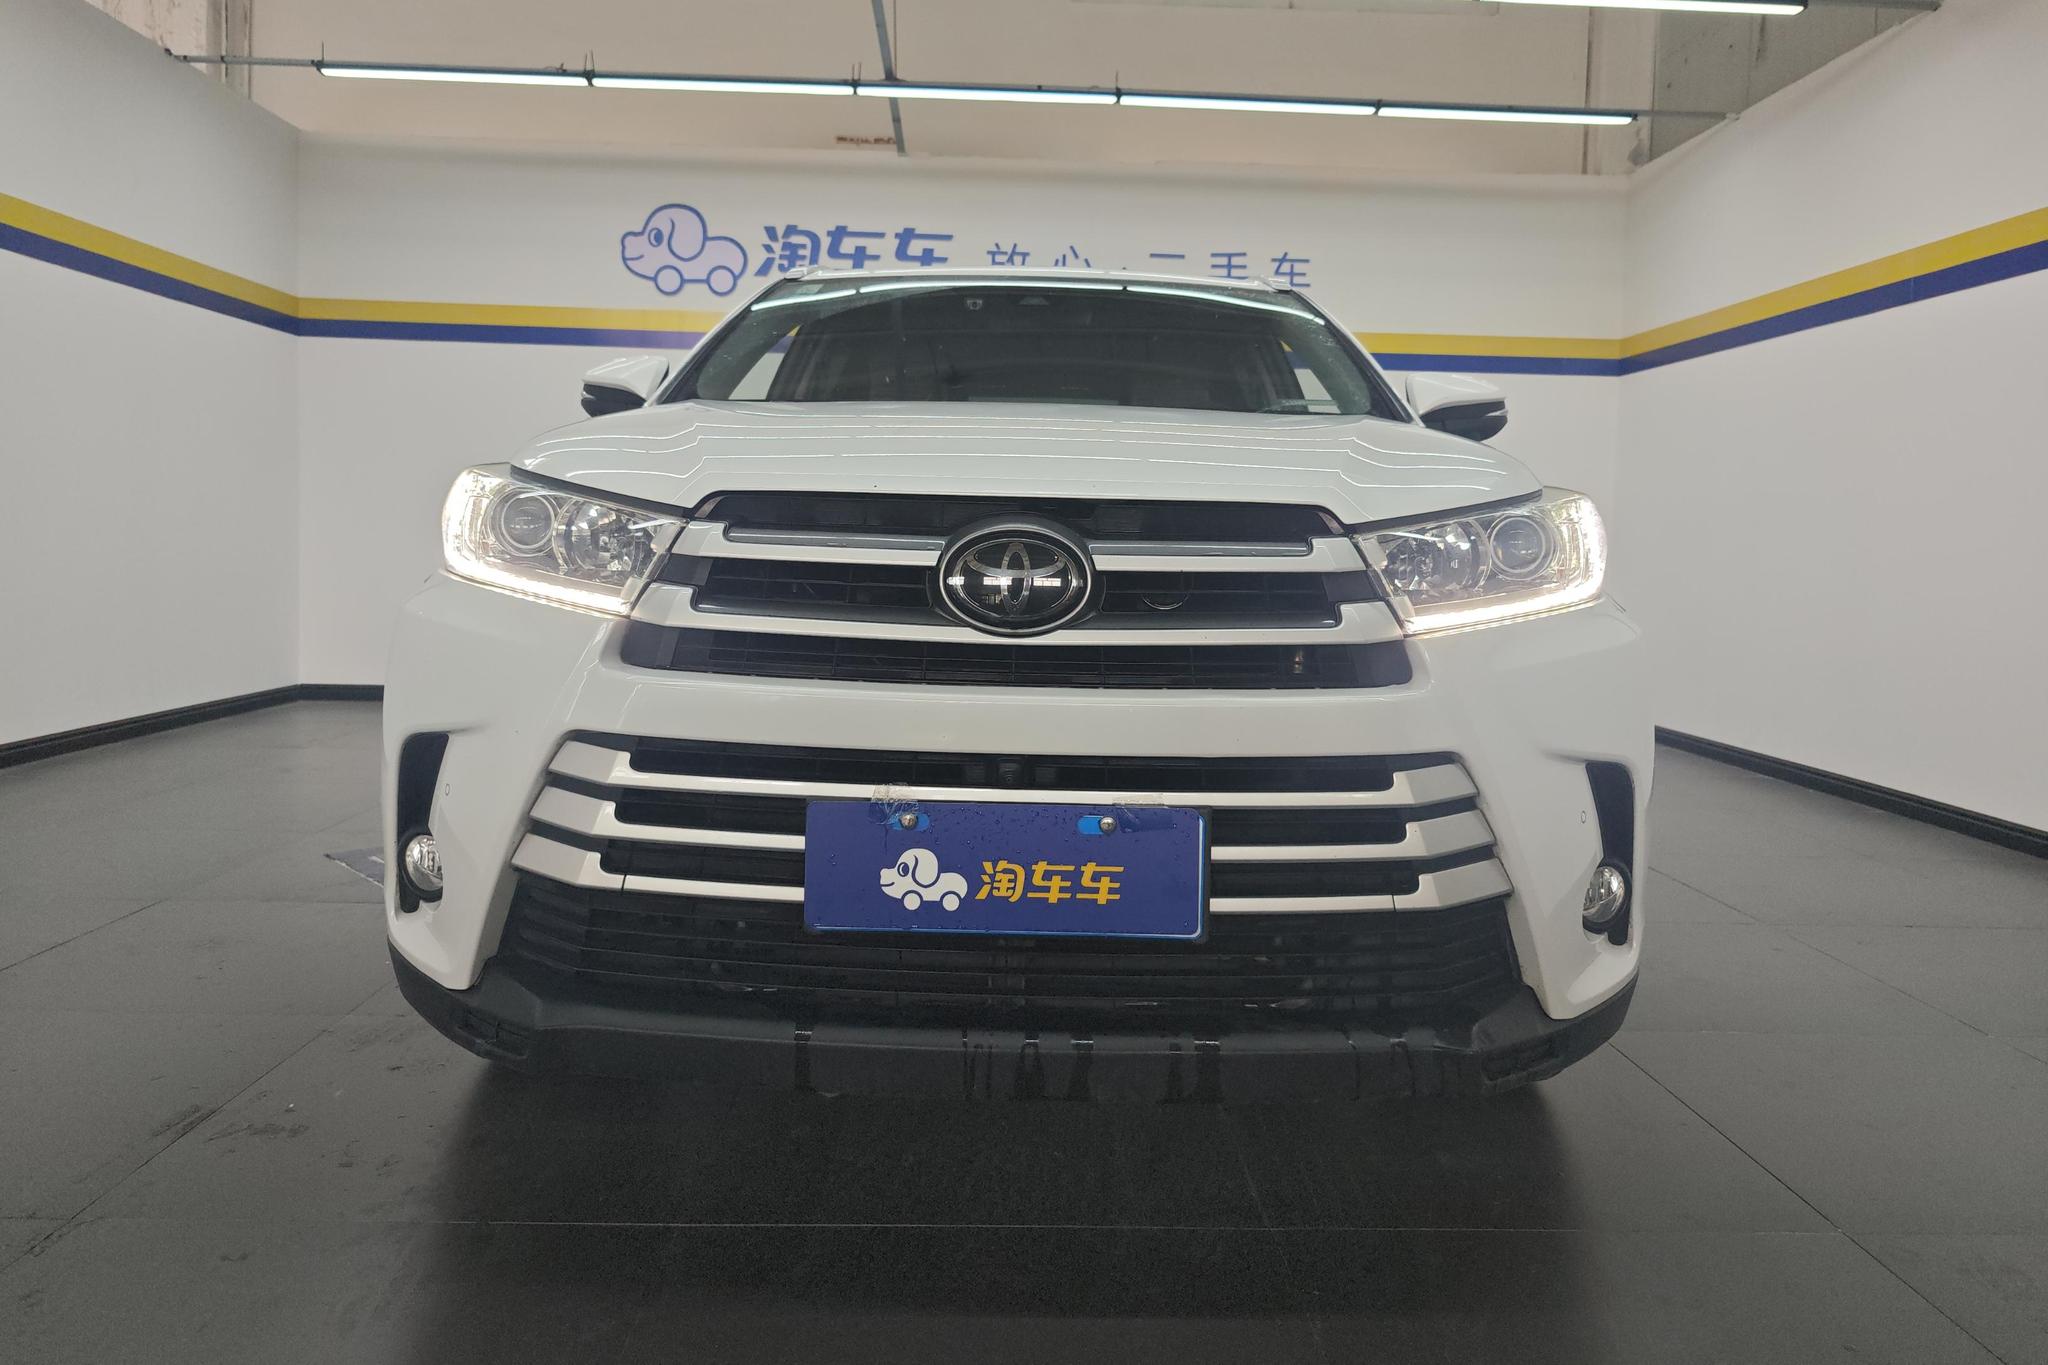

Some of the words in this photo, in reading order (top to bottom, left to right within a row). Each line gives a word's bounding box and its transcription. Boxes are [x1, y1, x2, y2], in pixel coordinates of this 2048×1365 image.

[754, 224, 954, 277] 淘车车
[974, 859, 1125, 905] 淘车车
